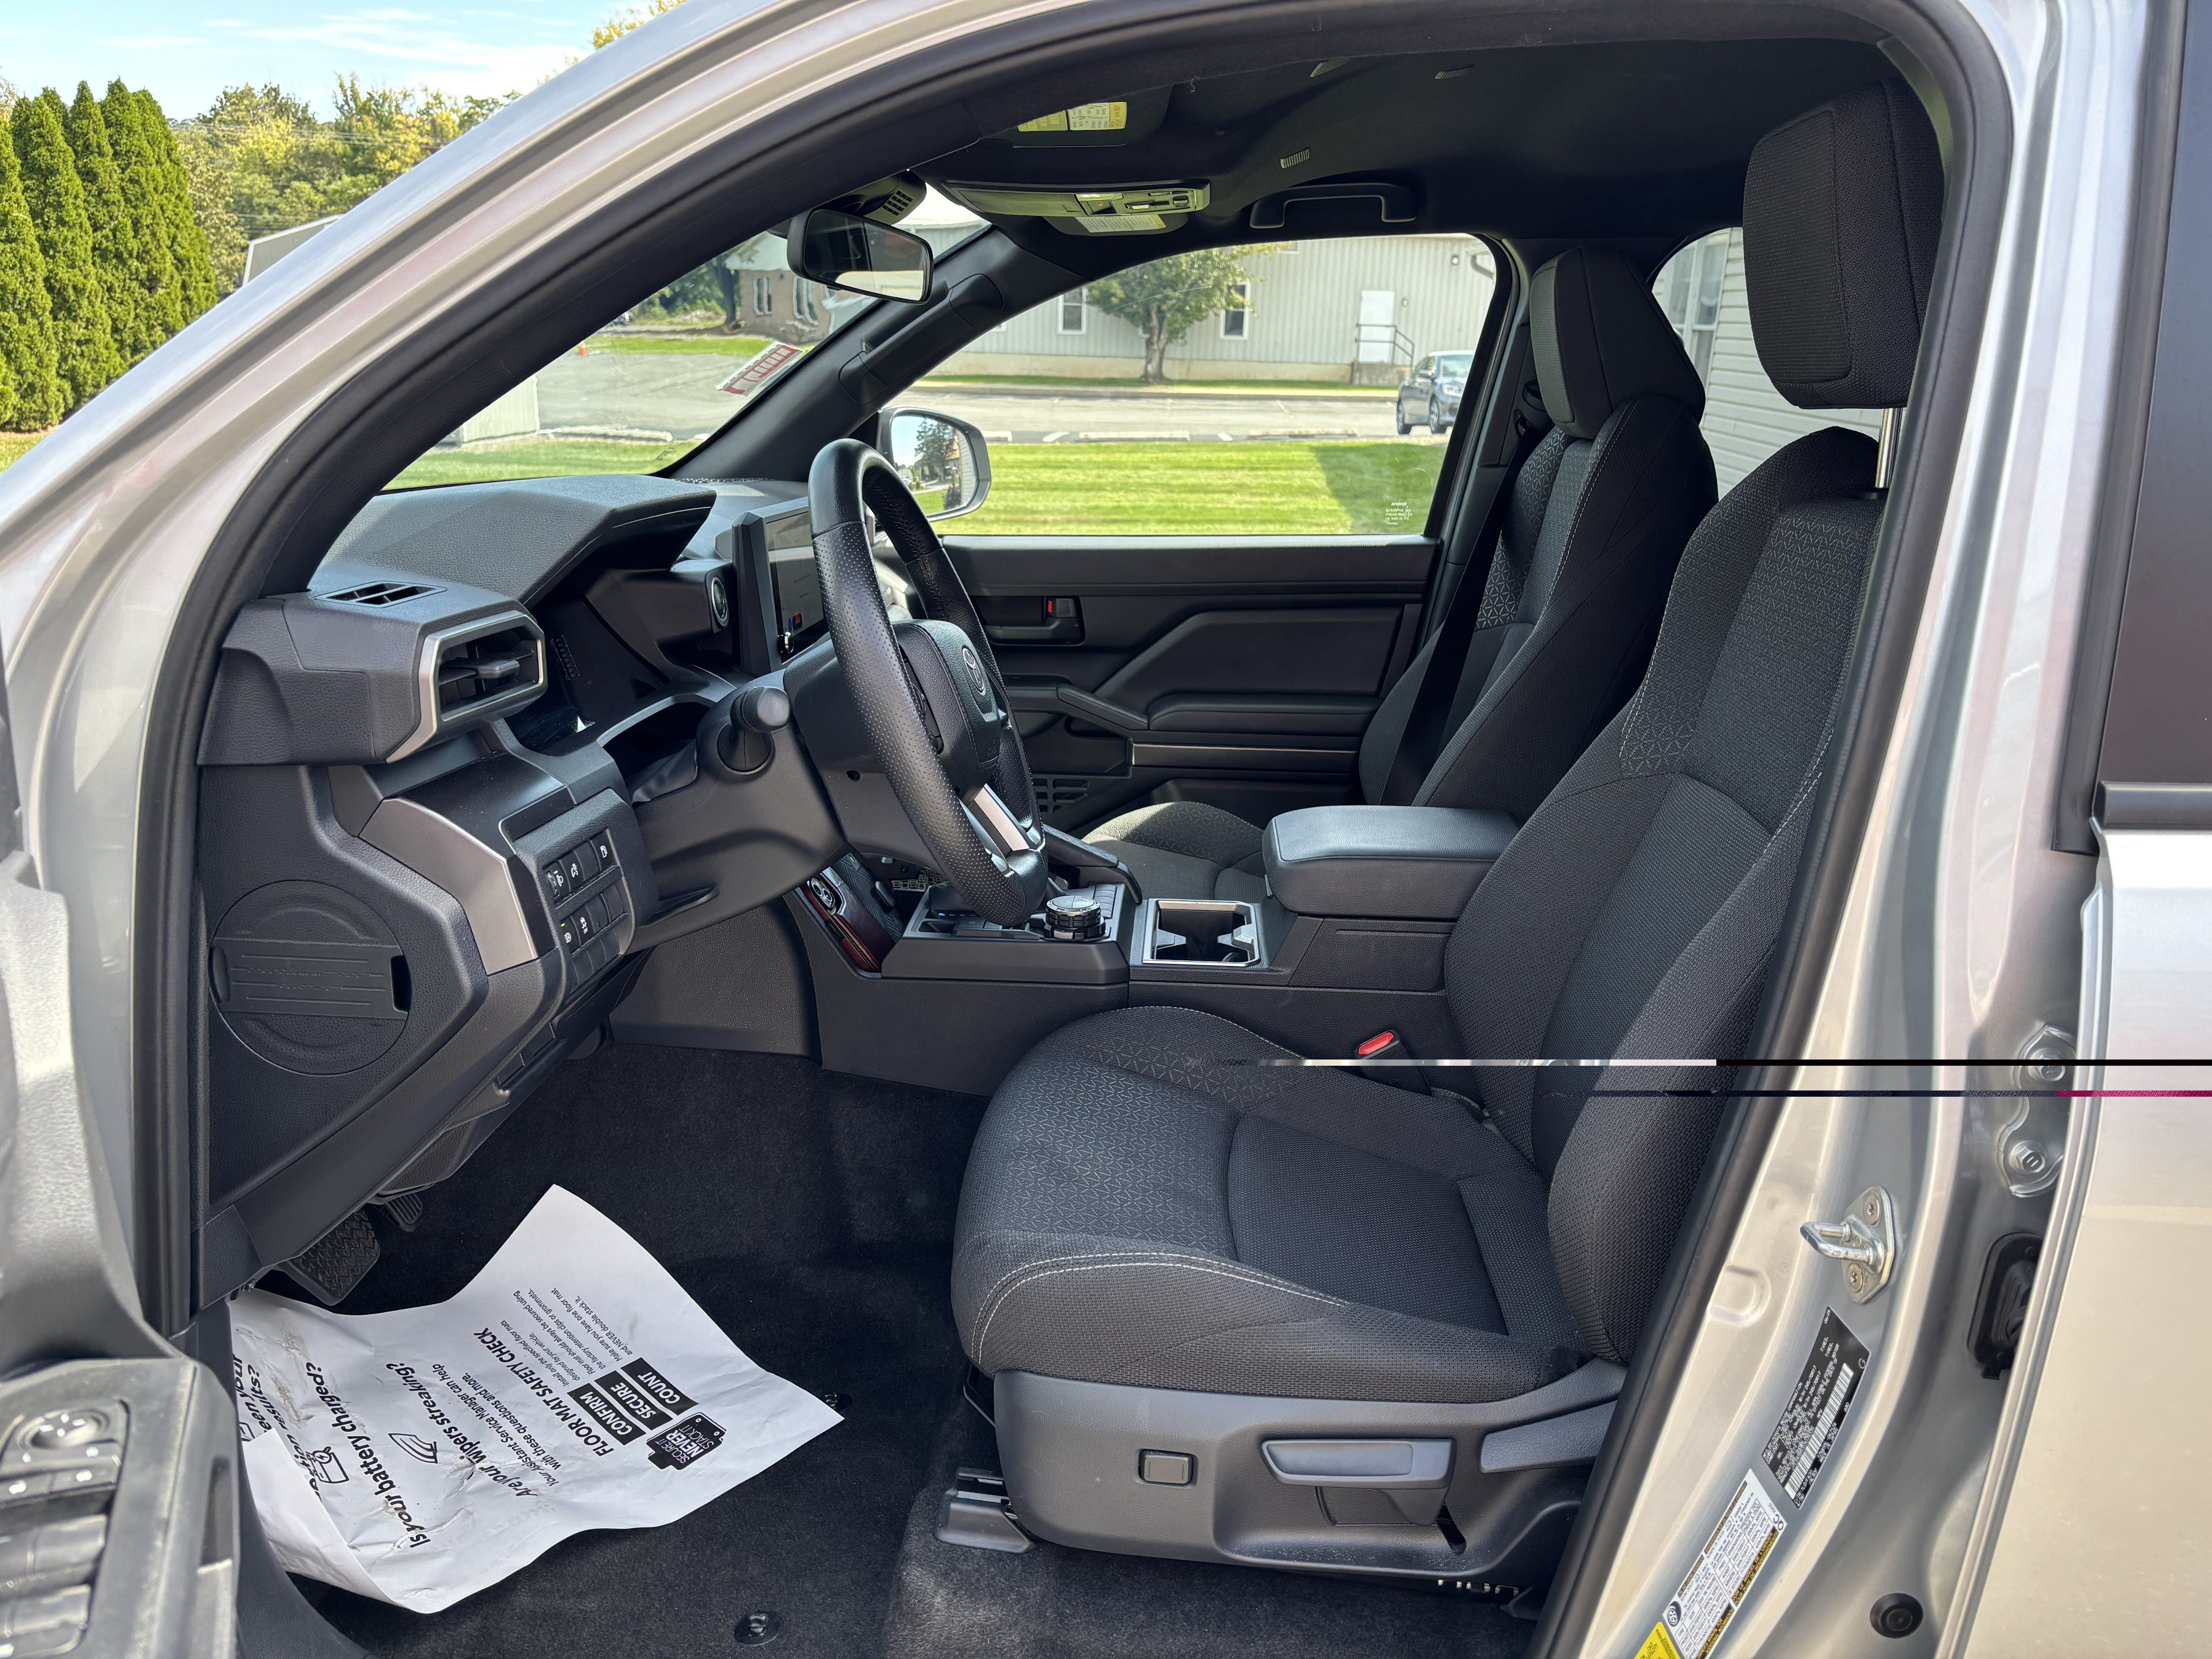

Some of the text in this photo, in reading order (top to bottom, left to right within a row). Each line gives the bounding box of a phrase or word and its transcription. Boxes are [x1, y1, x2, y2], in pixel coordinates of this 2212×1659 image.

[528, 1288, 553, 1314] grommets.
[579, 1301, 593, 1315] stack
[500, 1320, 513, 1331] mats
[513, 1290, 596, 1374] Floor mat should always be secured using
[551, 1288, 623, 1362] Make sure you have one floor mat
[554, 1319, 566, 1330] clips
[591, 1314, 609, 1331] double
[509, 1331, 522, 1341] floor
[529, 1332, 545, 1349] vehicle.
[563, 1329, 584, 1349] retention
[606, 1330, 624, 1348] NEVER
[518, 1340, 541, 1358] specified
[542, 1348, 557, 1357] your
[581, 1347, 599, 1363] factory
[620, 1346, 633, 1355] and
[544, 1363, 556, 1372] only
[556, 1362, 580, 1381] designed
[596, 1361, 606, 1369] the
[552, 1372, 570, 1386] Install
[637, 1372, 680, 1404] COUNT
[247, 1364, 289, 1432] results?
[473, 1328, 614, 1456] FLOOR MAT SAFETY CHECK
[610, 1382, 656, 1419] SECURE
[245, 1401, 271, 1433] een
[462, 1372, 561, 1470] with these questions and more.
[579, 1391, 632, 1435] CONFIRM
[386, 1363, 538, 1496] Are your wipers streaking?
[432, 1364, 559, 1487] Your Assistant Service Manager can help
[666, 1430, 704, 1458] NEVER
[678, 1425, 714, 1449] STACK IT
[306, 1362, 431, 1548] Is your battery charged?
[661, 1442, 690, 1463] SECURE
